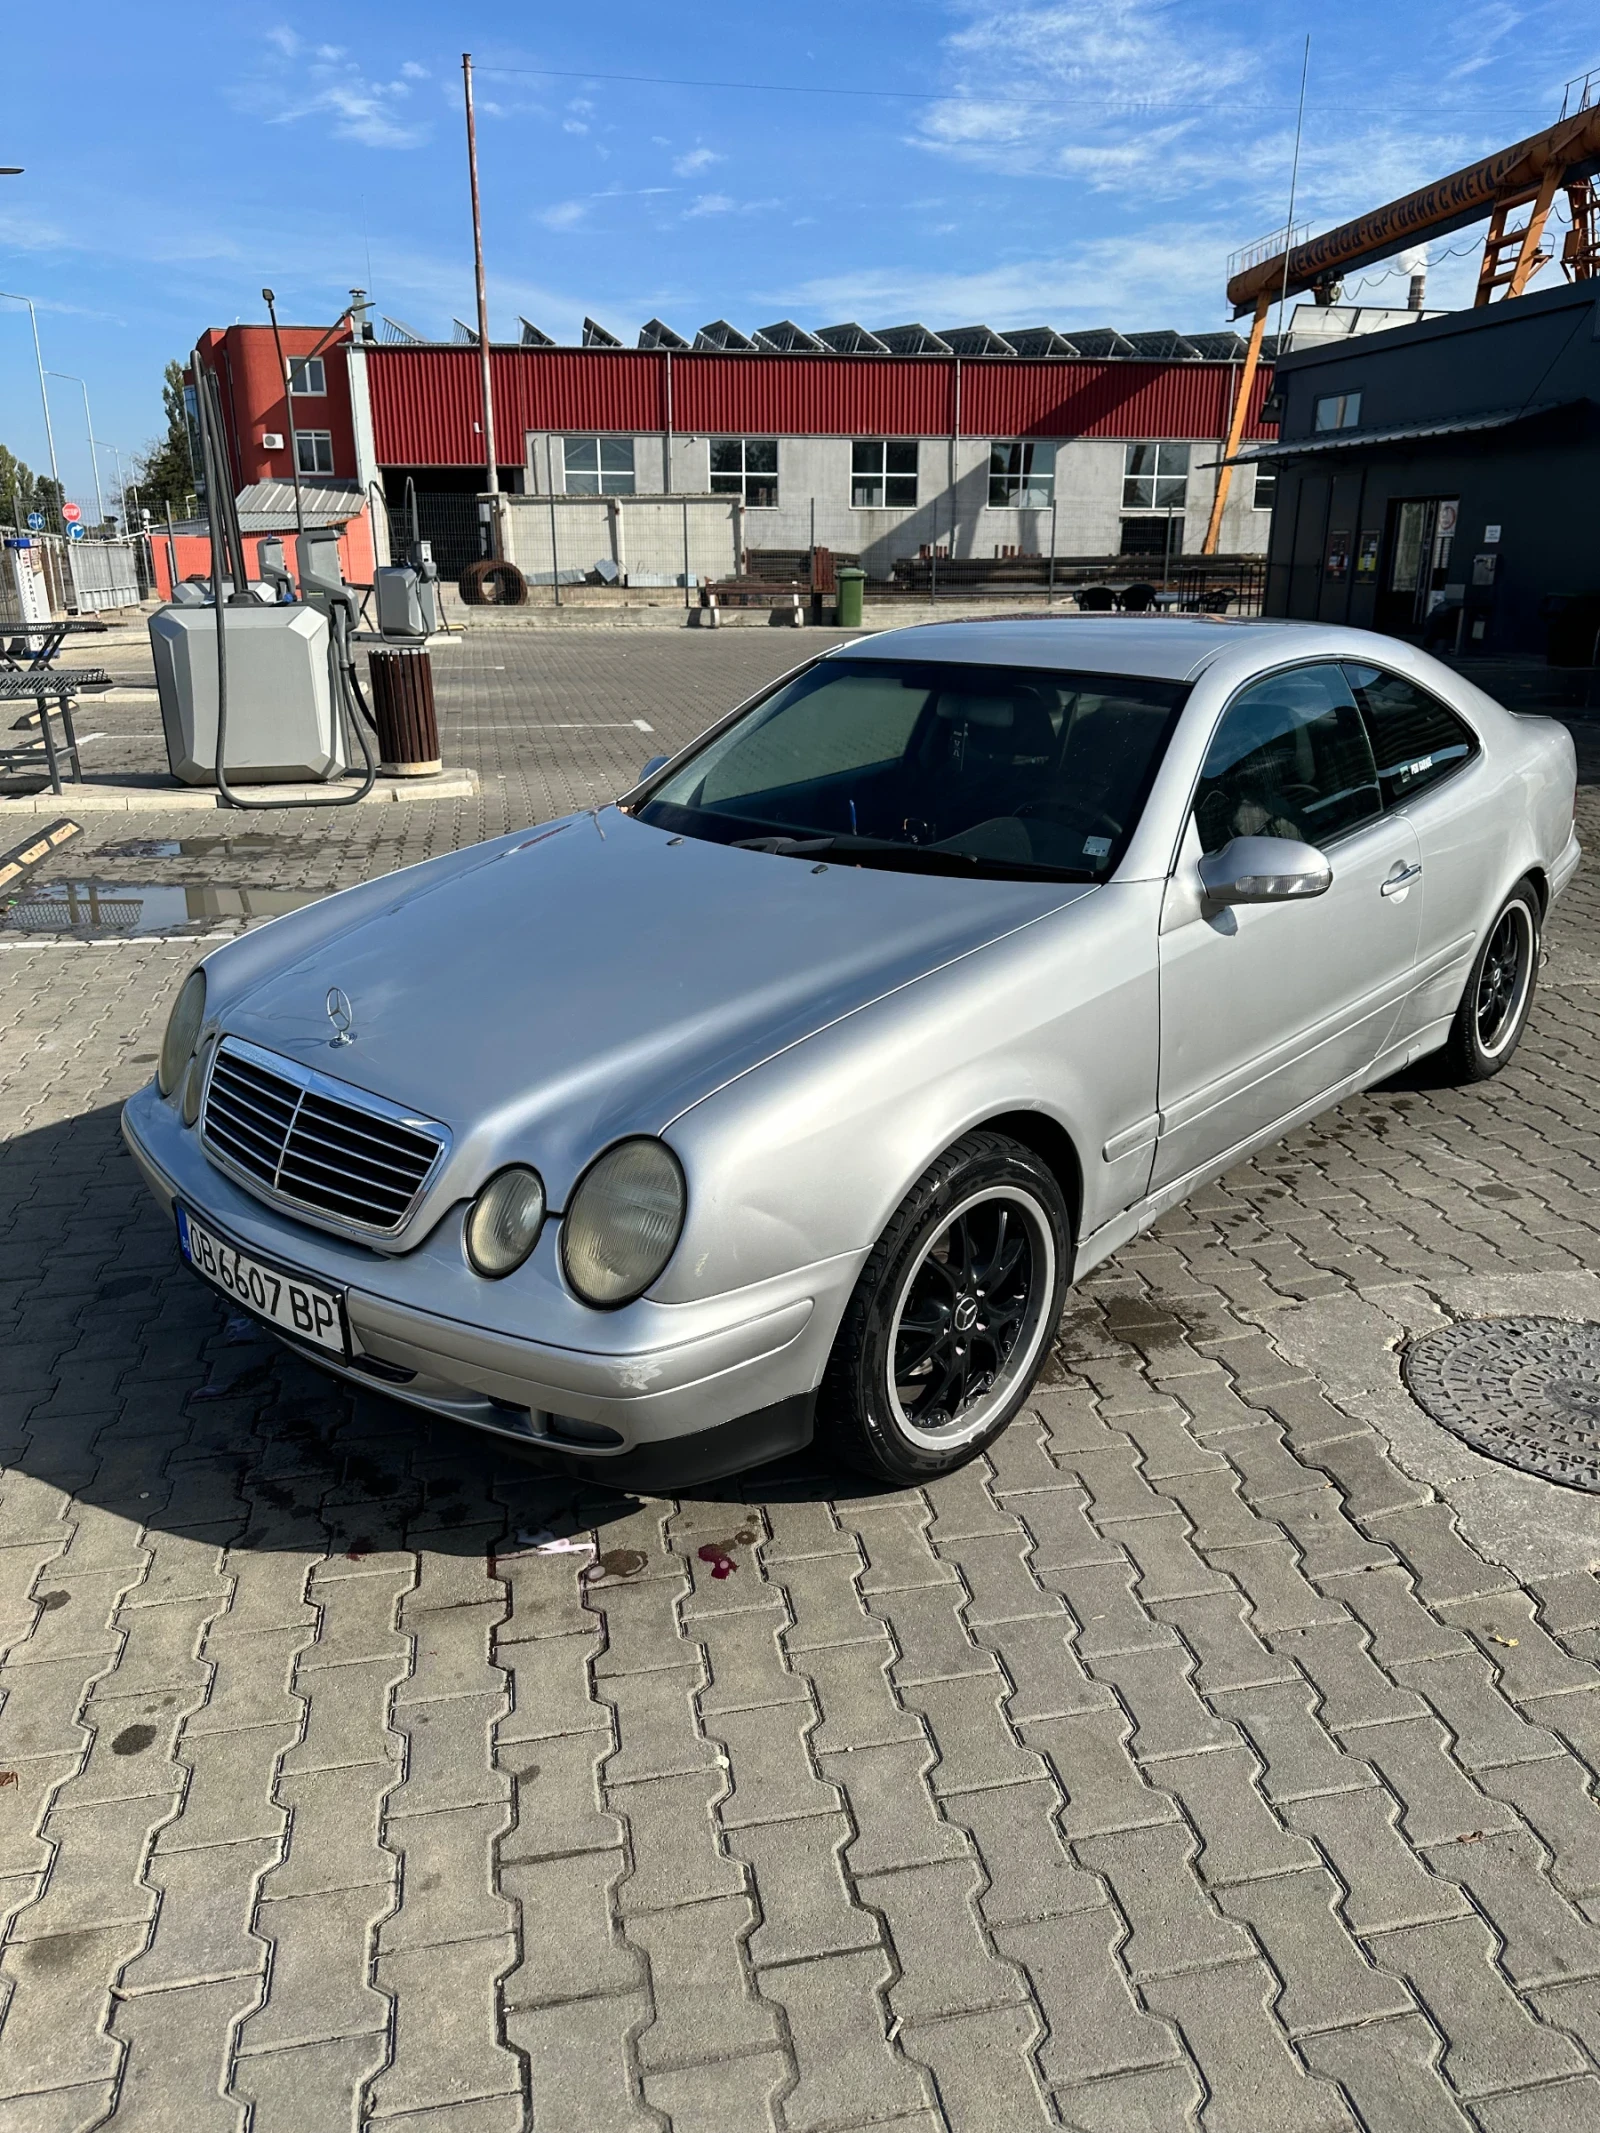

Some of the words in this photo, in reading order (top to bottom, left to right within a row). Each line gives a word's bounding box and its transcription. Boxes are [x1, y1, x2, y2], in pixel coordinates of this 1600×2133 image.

[190, 1223, 217, 1276] OB
[219, 1248, 281, 1317] 6607
[289, 1285, 333, 1338] BP
